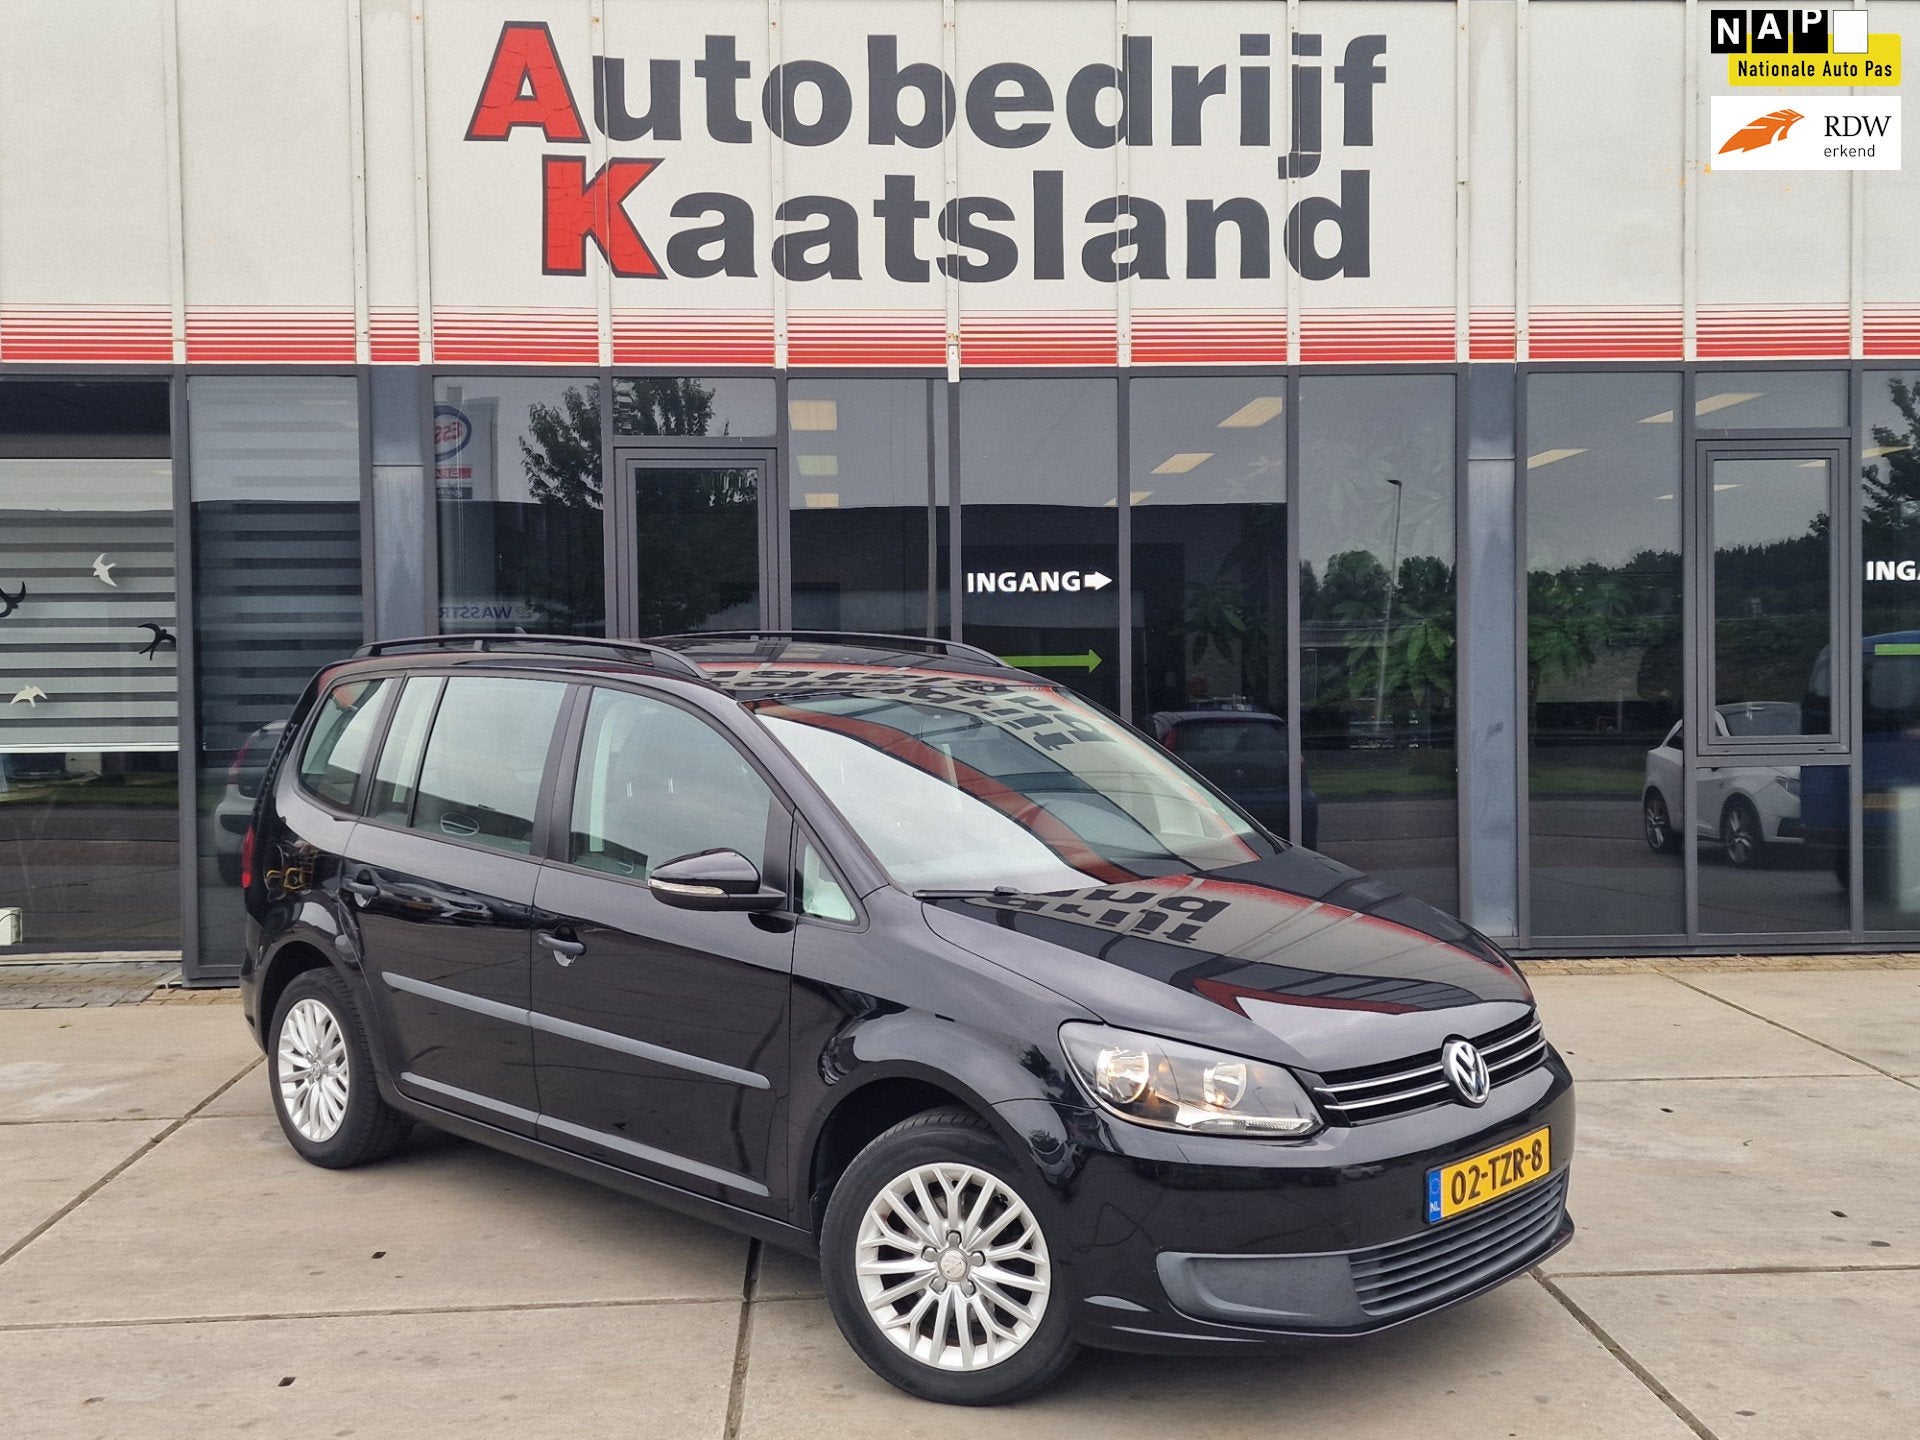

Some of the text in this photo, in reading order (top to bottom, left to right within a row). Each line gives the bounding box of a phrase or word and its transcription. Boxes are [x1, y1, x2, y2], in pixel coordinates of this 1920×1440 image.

[464, 21, 1388, 180] Autobedrijf
[542, 154, 1371, 282] Kaatsland
[967, 571, 1081, 593] INGANG
[1866, 560, 1920, 581] ING
[1451, 1138, 1544, 1206] 02-TZR-8
[1429, 1200, 1441, 1213] NL
